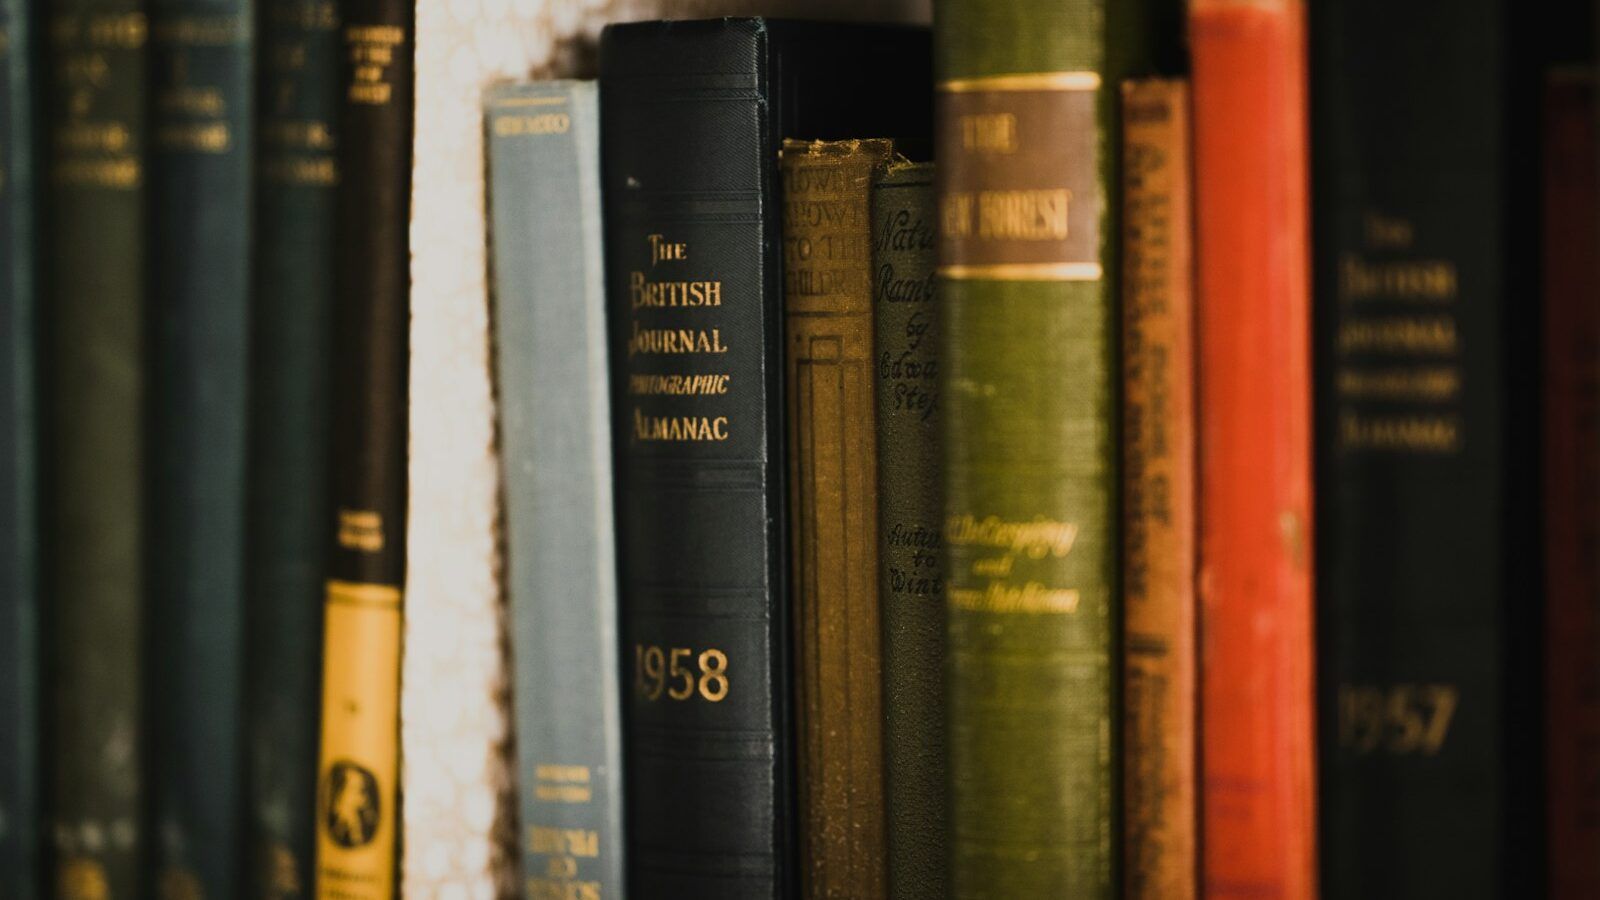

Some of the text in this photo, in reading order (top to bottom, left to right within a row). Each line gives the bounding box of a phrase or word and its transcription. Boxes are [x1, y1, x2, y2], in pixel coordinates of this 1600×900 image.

[648, 232, 688, 267] THE
[876, 210, 934, 251] Natu
[630, 271, 722, 309] BRITISH
[877, 263, 936, 302] Ramb
[627, 321, 728, 358] JOURNAL
[879, 351, 937, 380] Edwa
[630, 407, 729, 445] ALMANAC
[889, 567, 943, 594] Wint
[634, 643, 730, 702] 1958
